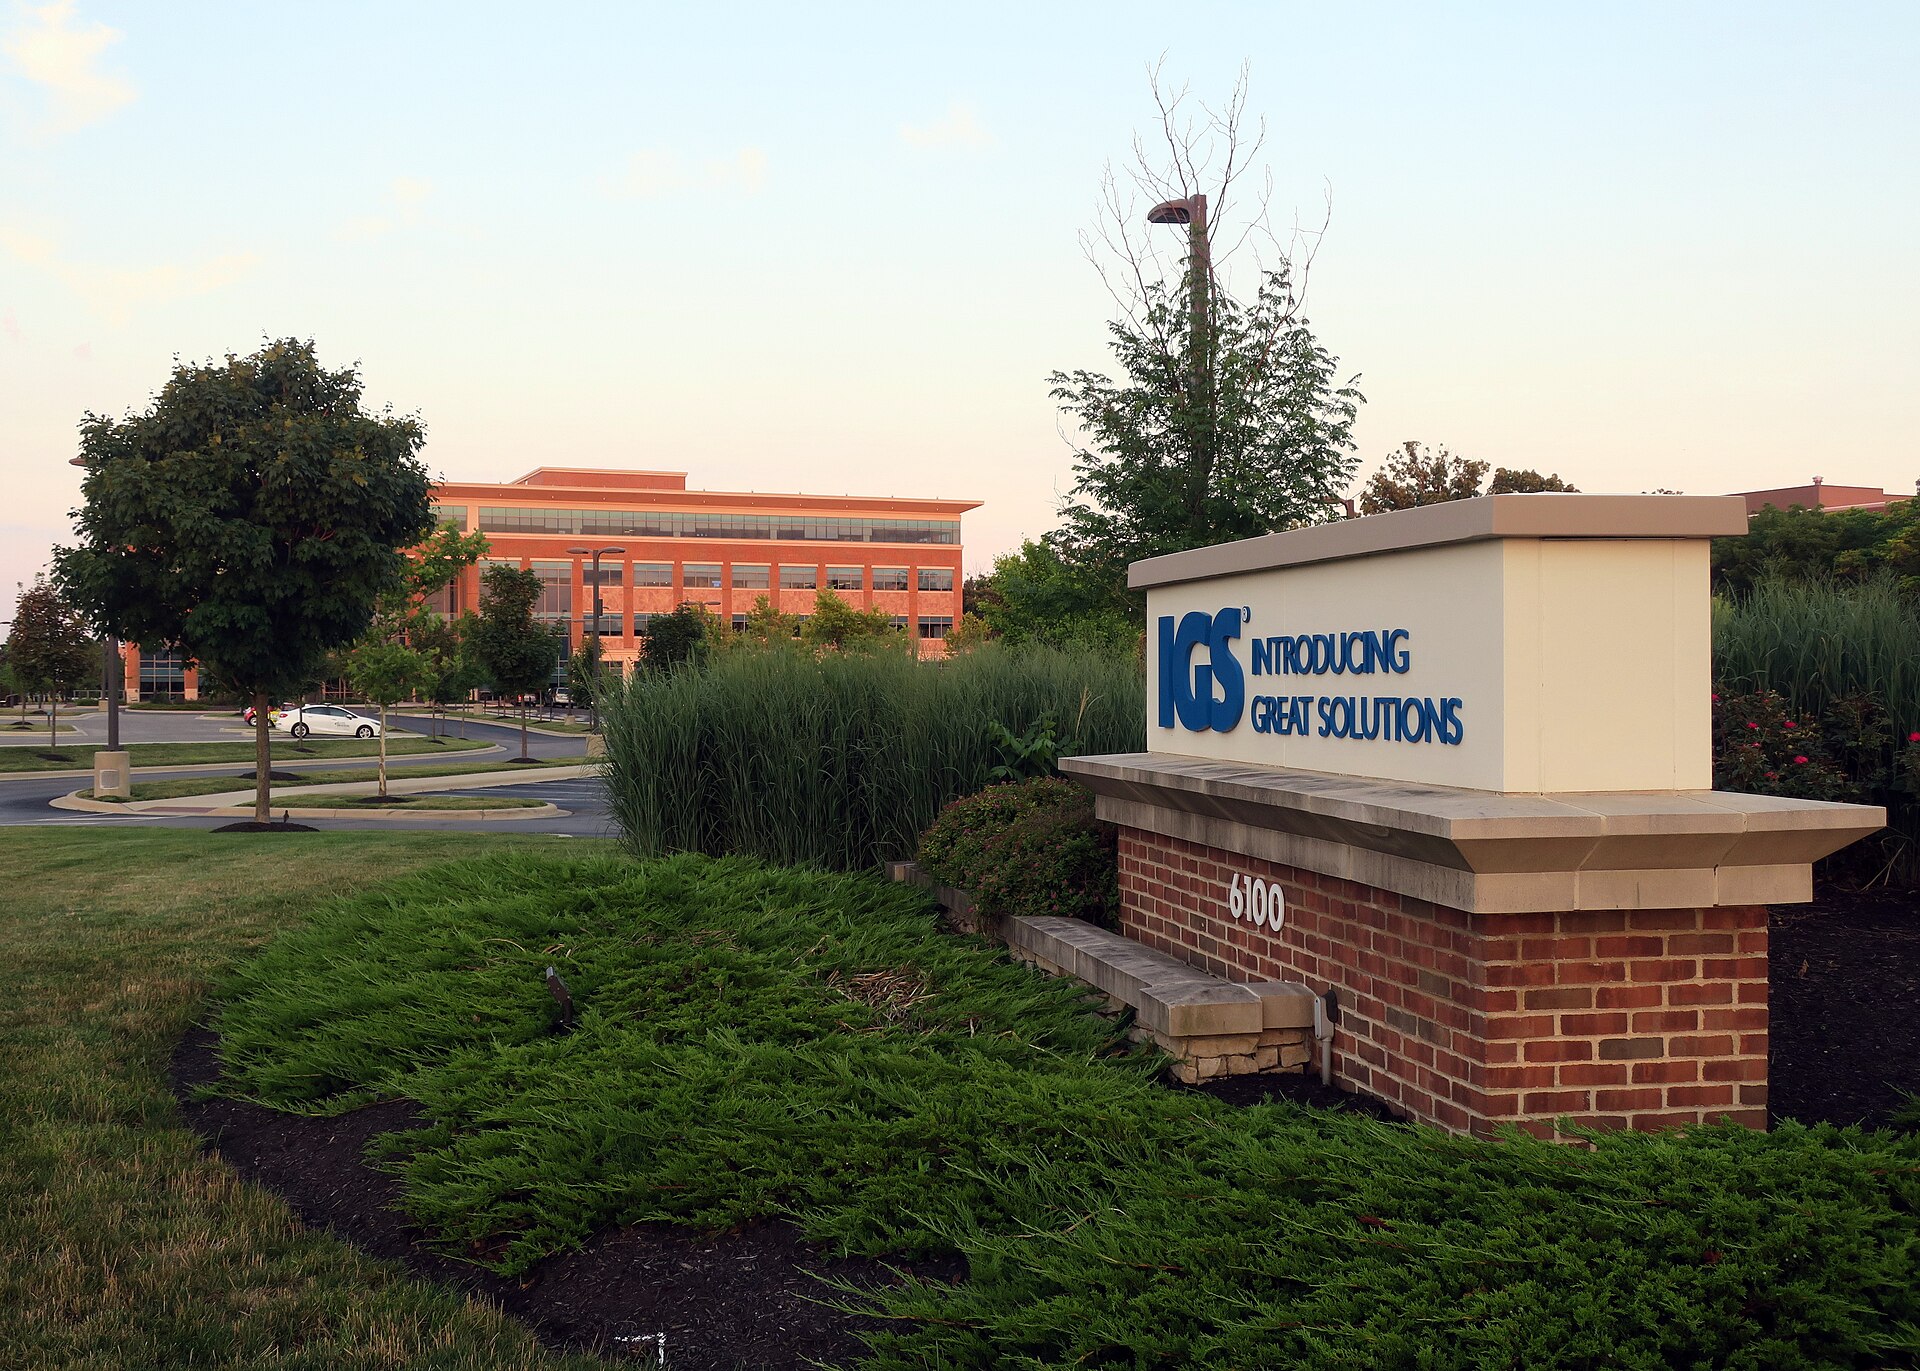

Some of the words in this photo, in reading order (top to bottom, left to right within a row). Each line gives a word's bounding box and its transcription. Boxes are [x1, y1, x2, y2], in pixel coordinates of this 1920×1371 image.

[1158, 607, 1245, 733] IGS
[1251, 629, 1410, 676] INTRODUCING
[1250, 695, 1314, 736] GREAT
[1318, 696, 1463, 746] SOLUTIONS
[1229, 873, 1285, 932] 6100
